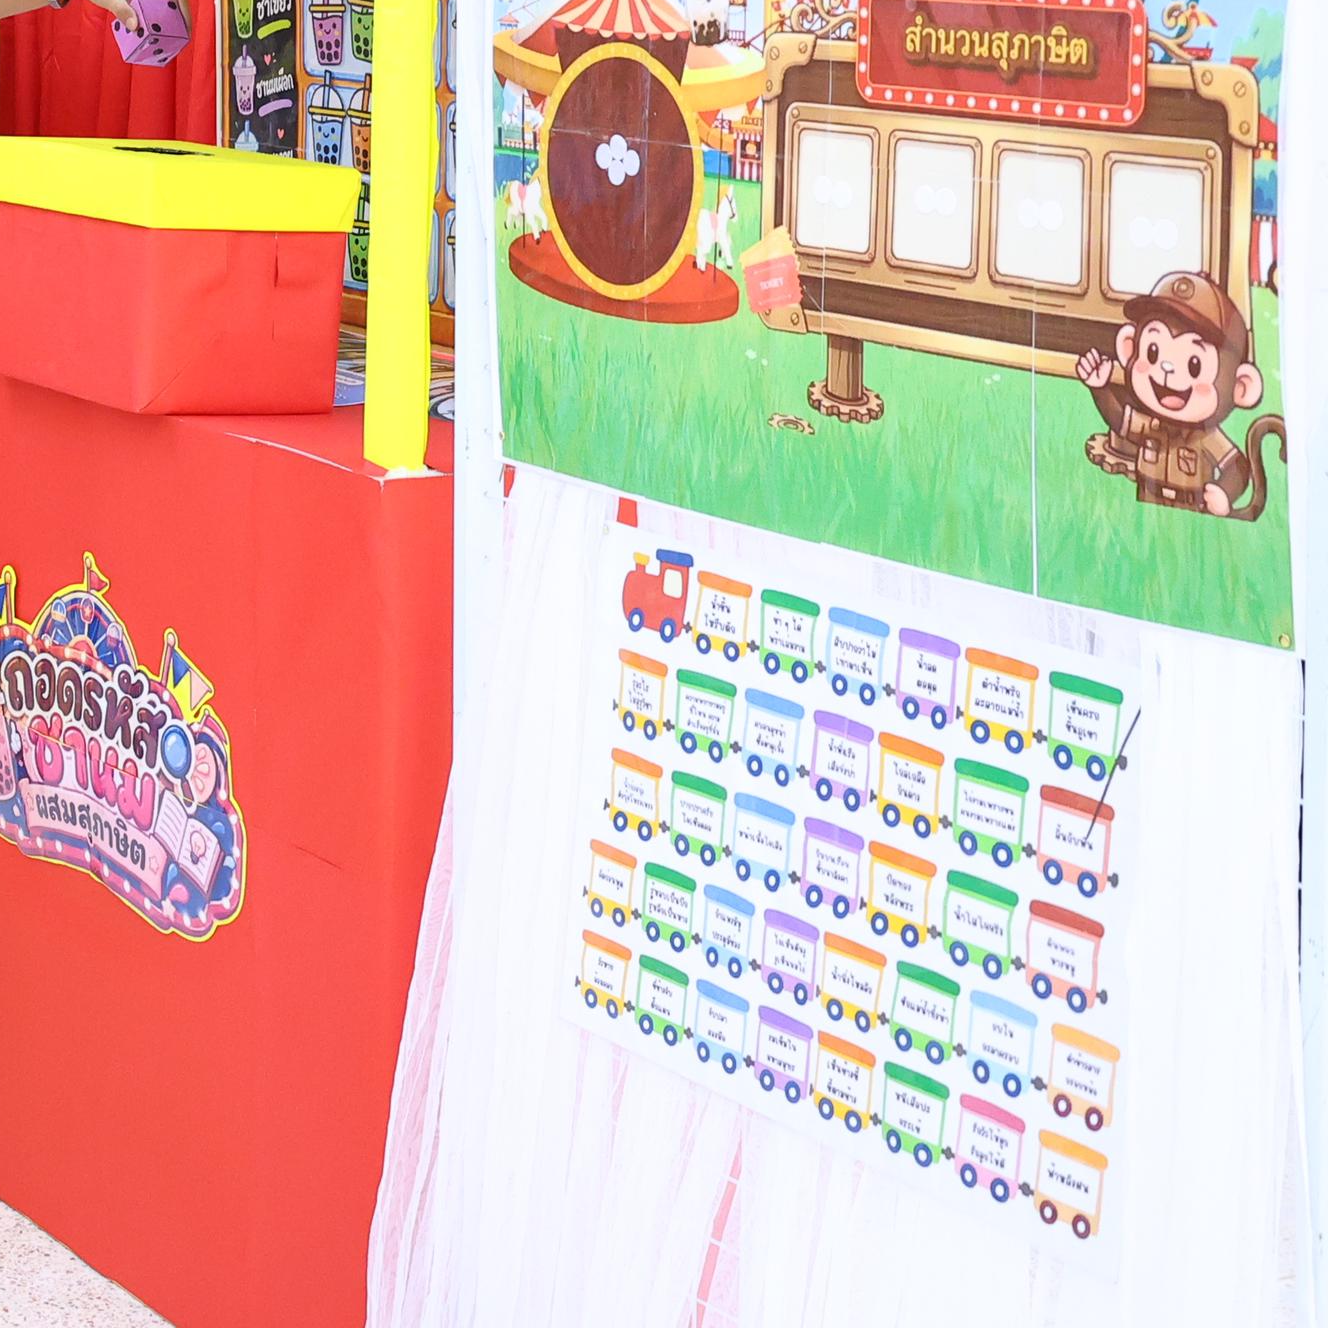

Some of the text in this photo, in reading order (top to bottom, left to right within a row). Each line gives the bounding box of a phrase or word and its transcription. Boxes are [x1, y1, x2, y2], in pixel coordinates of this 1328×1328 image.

[256, 68, 294, 99] ชานมเผือก
[904, 13, 1090, 76] สำนวนสุภาษิต
[4, 654, 168, 769] ถอดรหัส
[28, 712, 155, 832] ชานม
[35, 792, 146, 870] ผสมสุภาษิต
